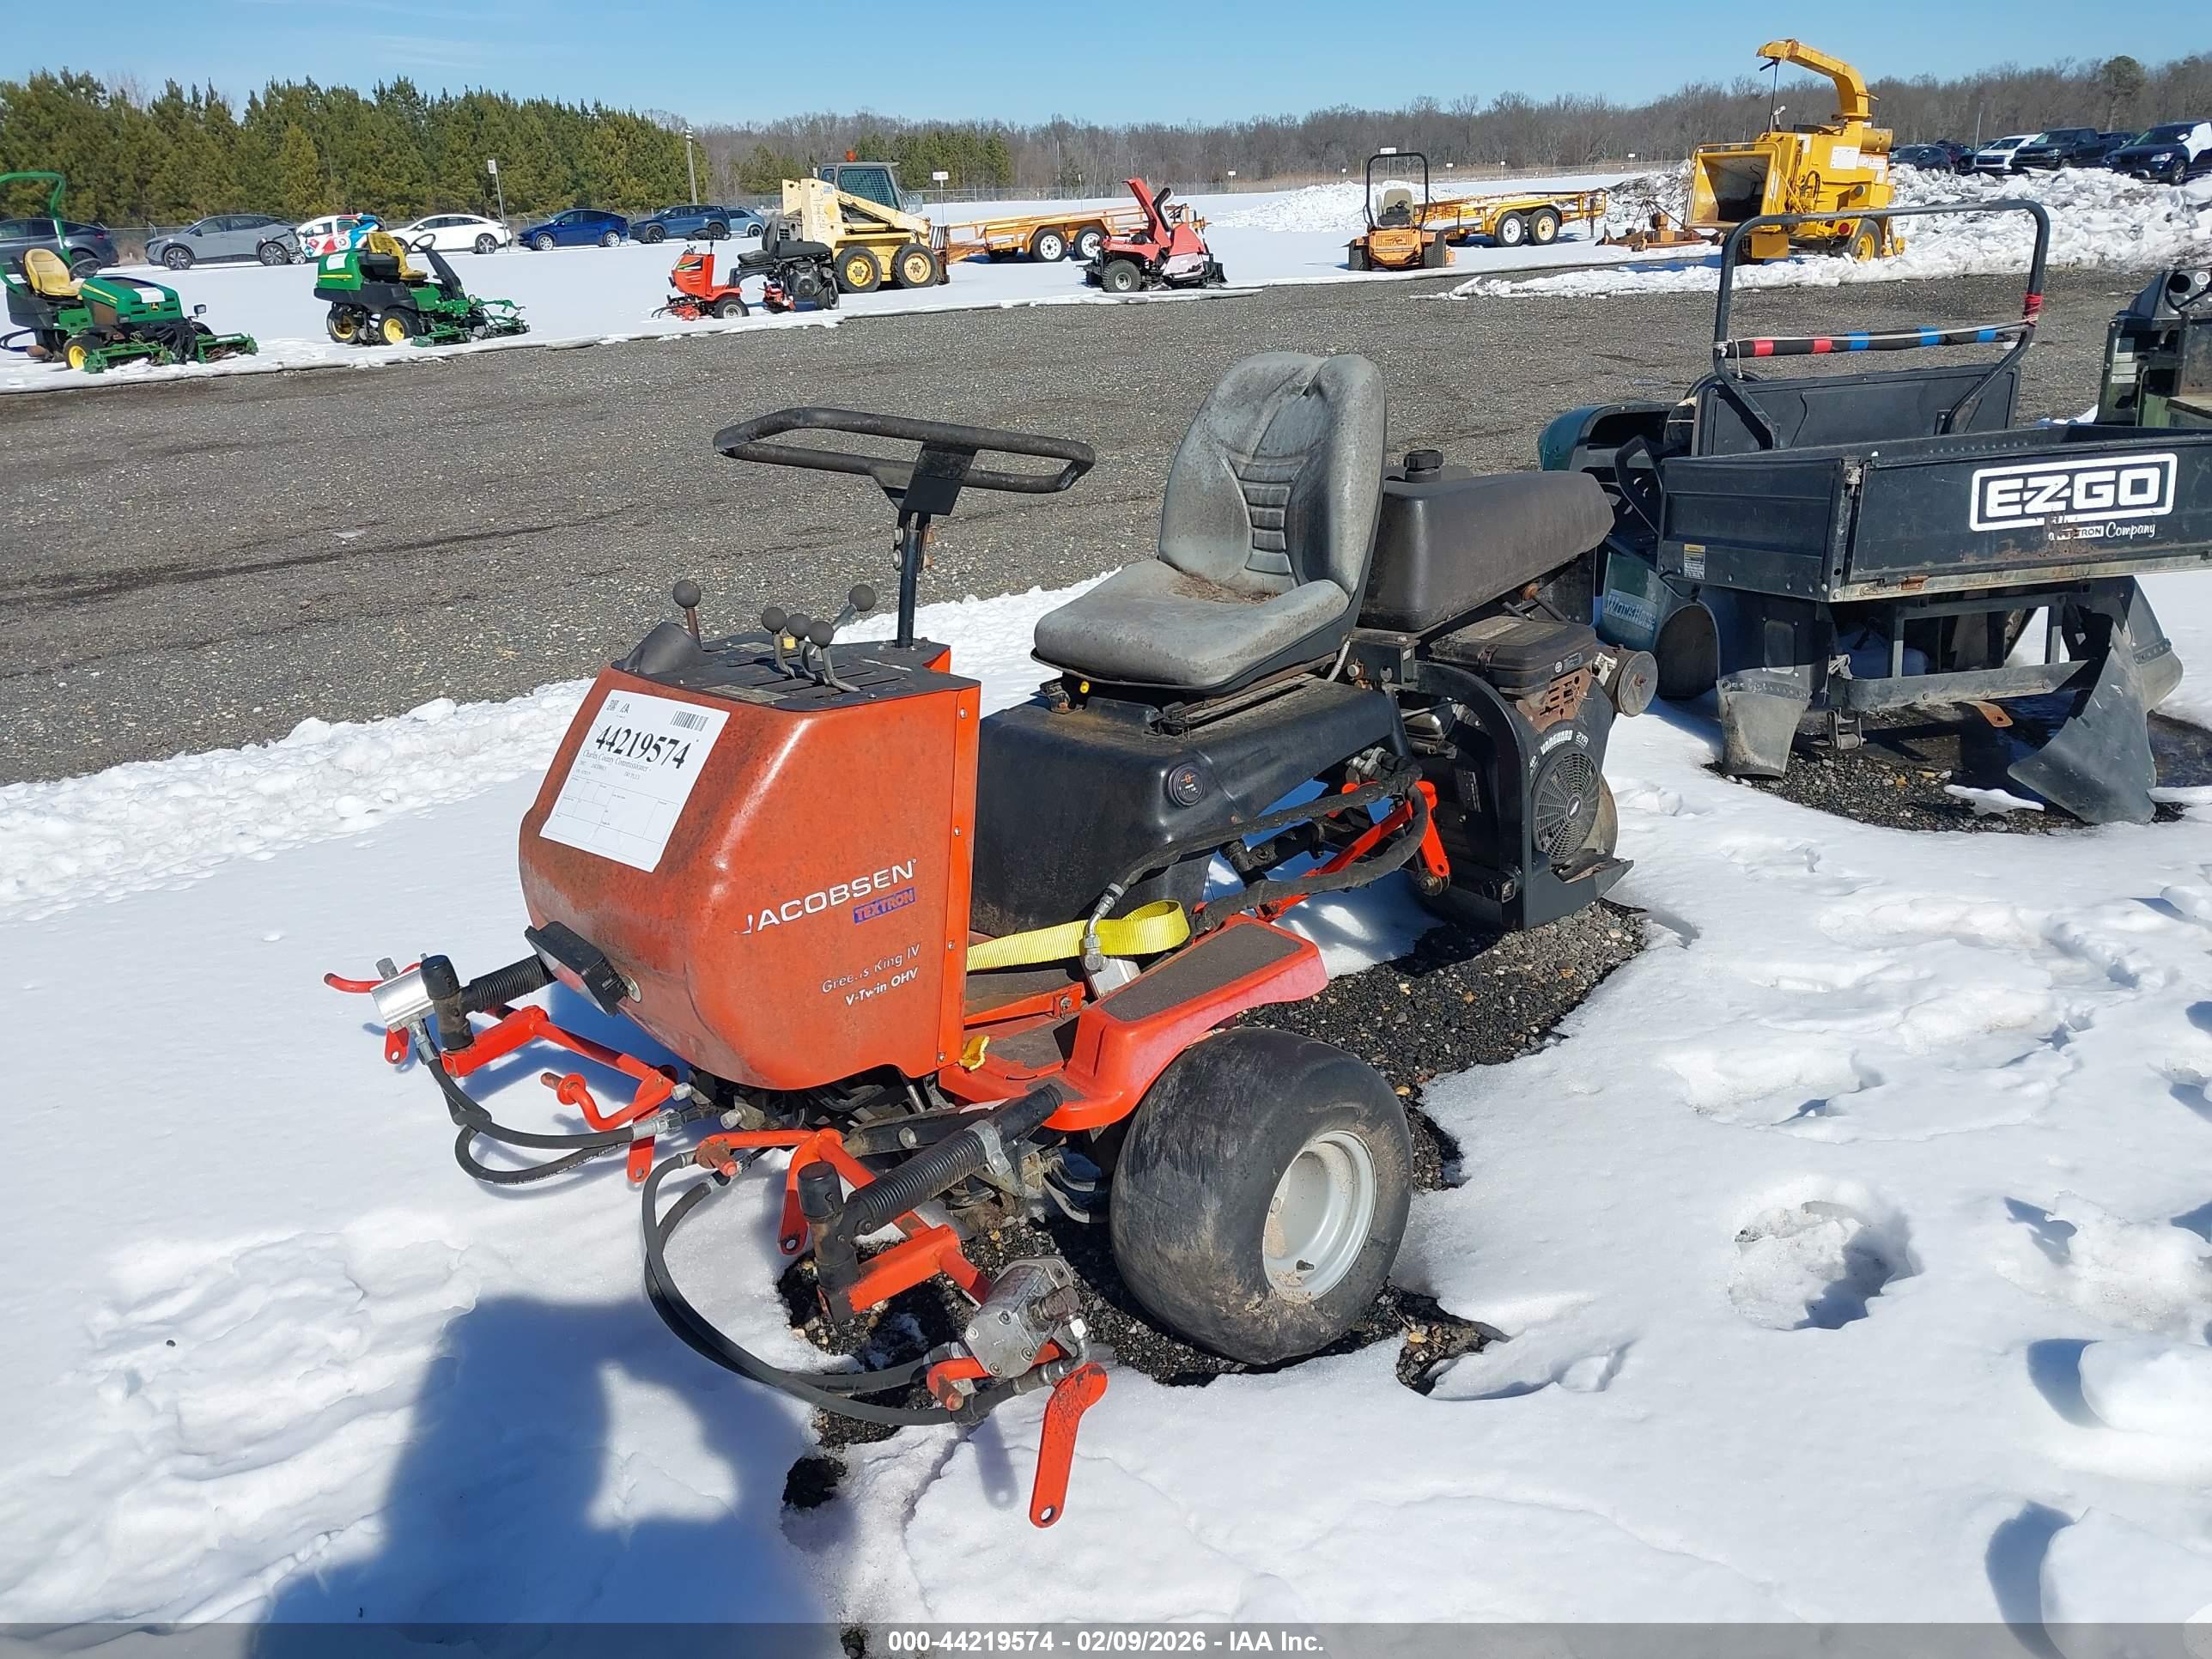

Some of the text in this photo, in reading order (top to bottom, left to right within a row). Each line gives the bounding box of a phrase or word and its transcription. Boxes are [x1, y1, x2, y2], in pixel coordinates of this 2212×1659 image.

[2106, 522, 2155, 539] Company
[595, 724, 692, 769] 44219574
[1540, 729, 1573, 756] VANGUARD
[732, 860, 915, 934] JACOBSEN
[855, 890, 914, 922] TEXTRON
[874, 954, 902, 972] King
[907, 944, 921, 960] IV
[845, 968, 919, 1006] V-Twin OHV
